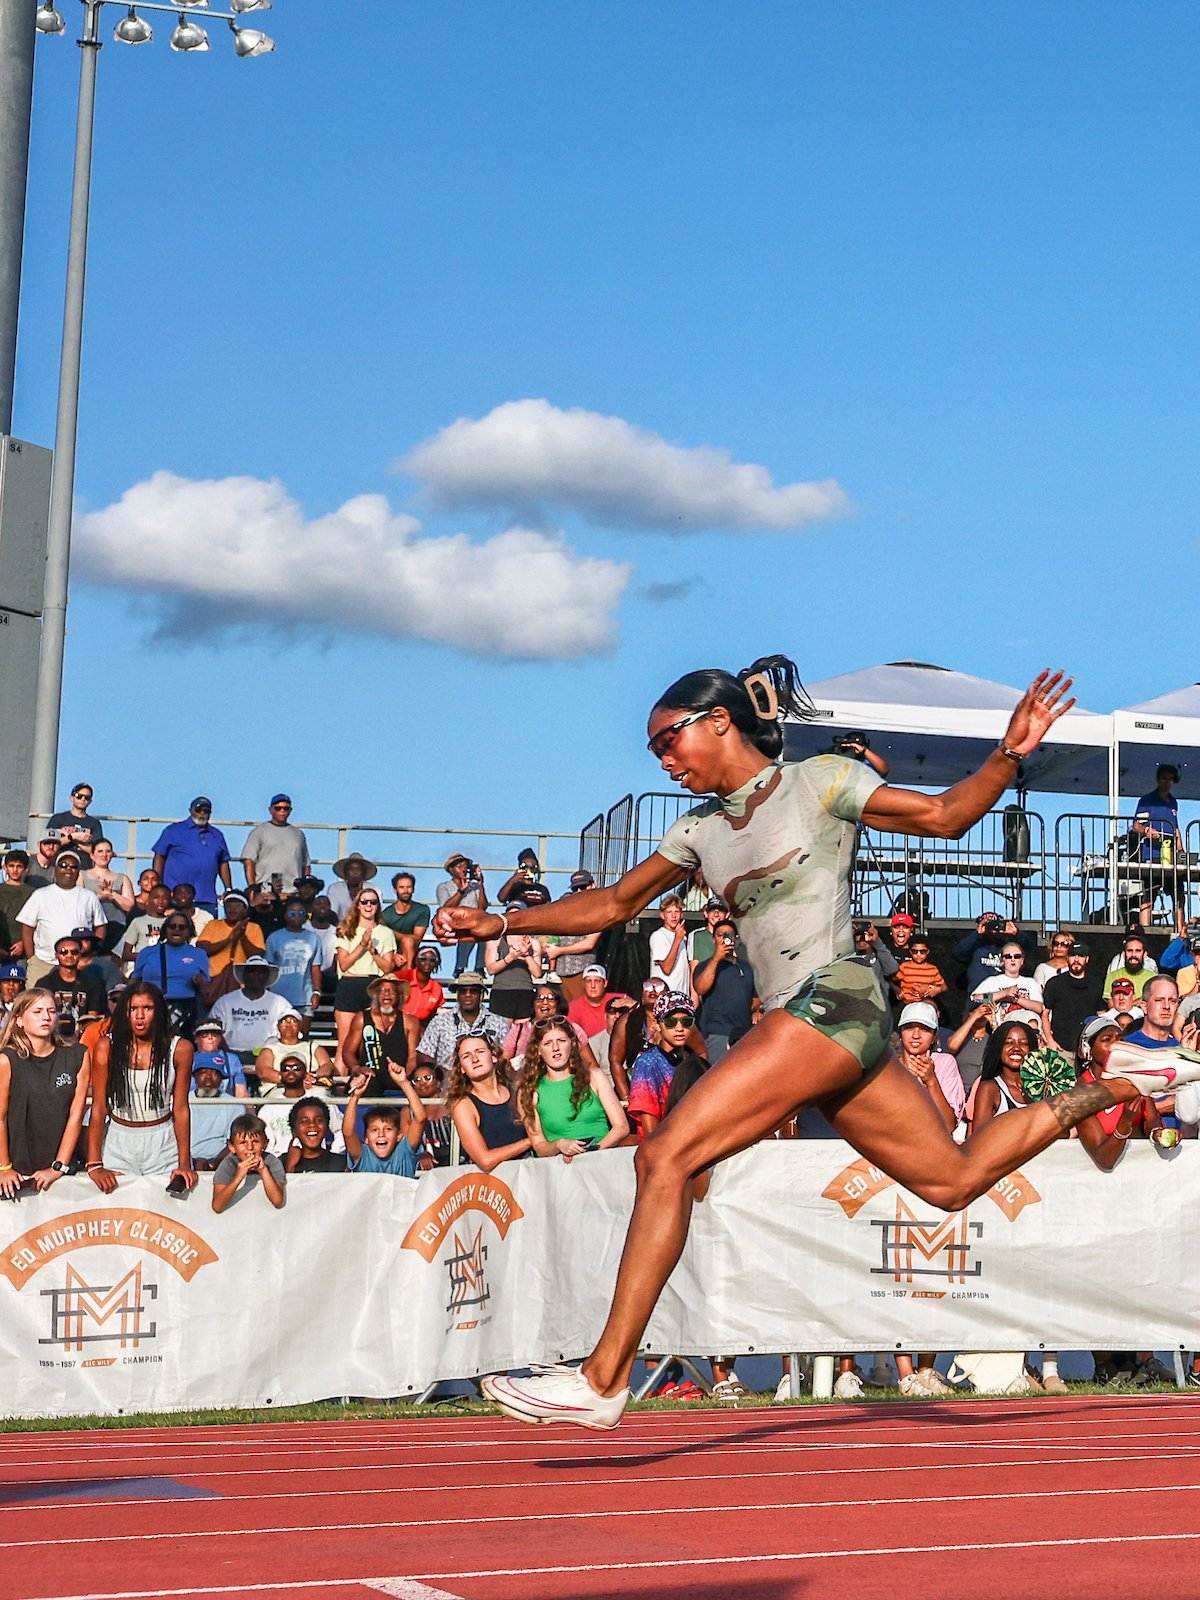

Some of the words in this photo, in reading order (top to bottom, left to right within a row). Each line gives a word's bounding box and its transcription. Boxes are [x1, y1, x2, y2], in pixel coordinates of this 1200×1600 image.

[843, 1176, 867, 1200] ED
[418, 1222, 440, 1245] ED
[437, 1184, 476, 1226] MURPHEY
[477, 1185, 512, 1224] CLASSIC
[11, 1248, 36, 1272] ED
[36, 1219, 124, 1254] MURPHEY
[129, 1220, 199, 1265] CLASSIC
[61, 1360, 77, 1368] 1957
[122, 1355, 163, 1365] CHAMPION
